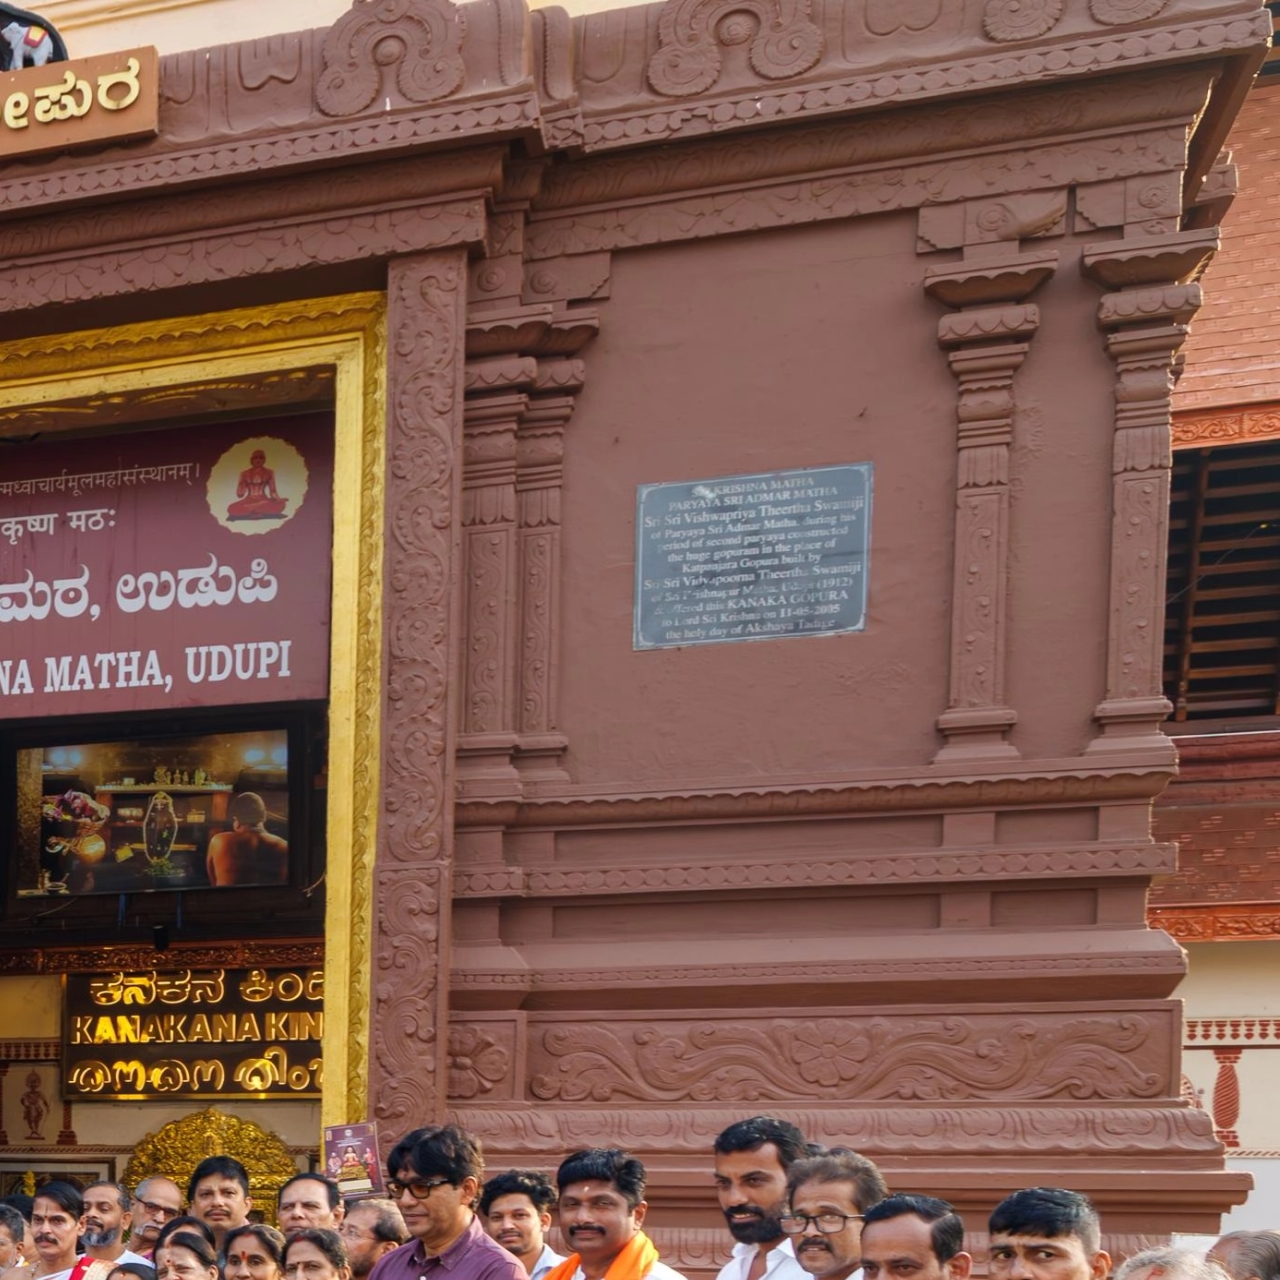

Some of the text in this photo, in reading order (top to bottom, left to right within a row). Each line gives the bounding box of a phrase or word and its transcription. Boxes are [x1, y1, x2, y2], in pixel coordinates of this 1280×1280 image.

[714, 482, 767, 495] KRISHNA
[770, 477, 815, 490] MATHA
[668, 498, 721, 512] PARYAYA
[745, 490, 791, 504] ADMAR
[793, 486, 838, 499] MATHA
[67, 508, 116, 532] मठः
[664, 513, 681, 526] Sri
[665, 527, 706, 539] Paryaya
[707, 524, 723, 535] Sri
[116, 552, 278, 614] ಉಡುಪಿ
[727, 594, 787, 609] KANAKA
[790, 589, 849, 604] GOPURA
[44, 650, 173, 693] MATHA,
[185, 640, 292, 683] UDUPI
[90, 969, 225, 1006] ಕನಕನ
[70, 1012, 262, 1044] KANAKANA
